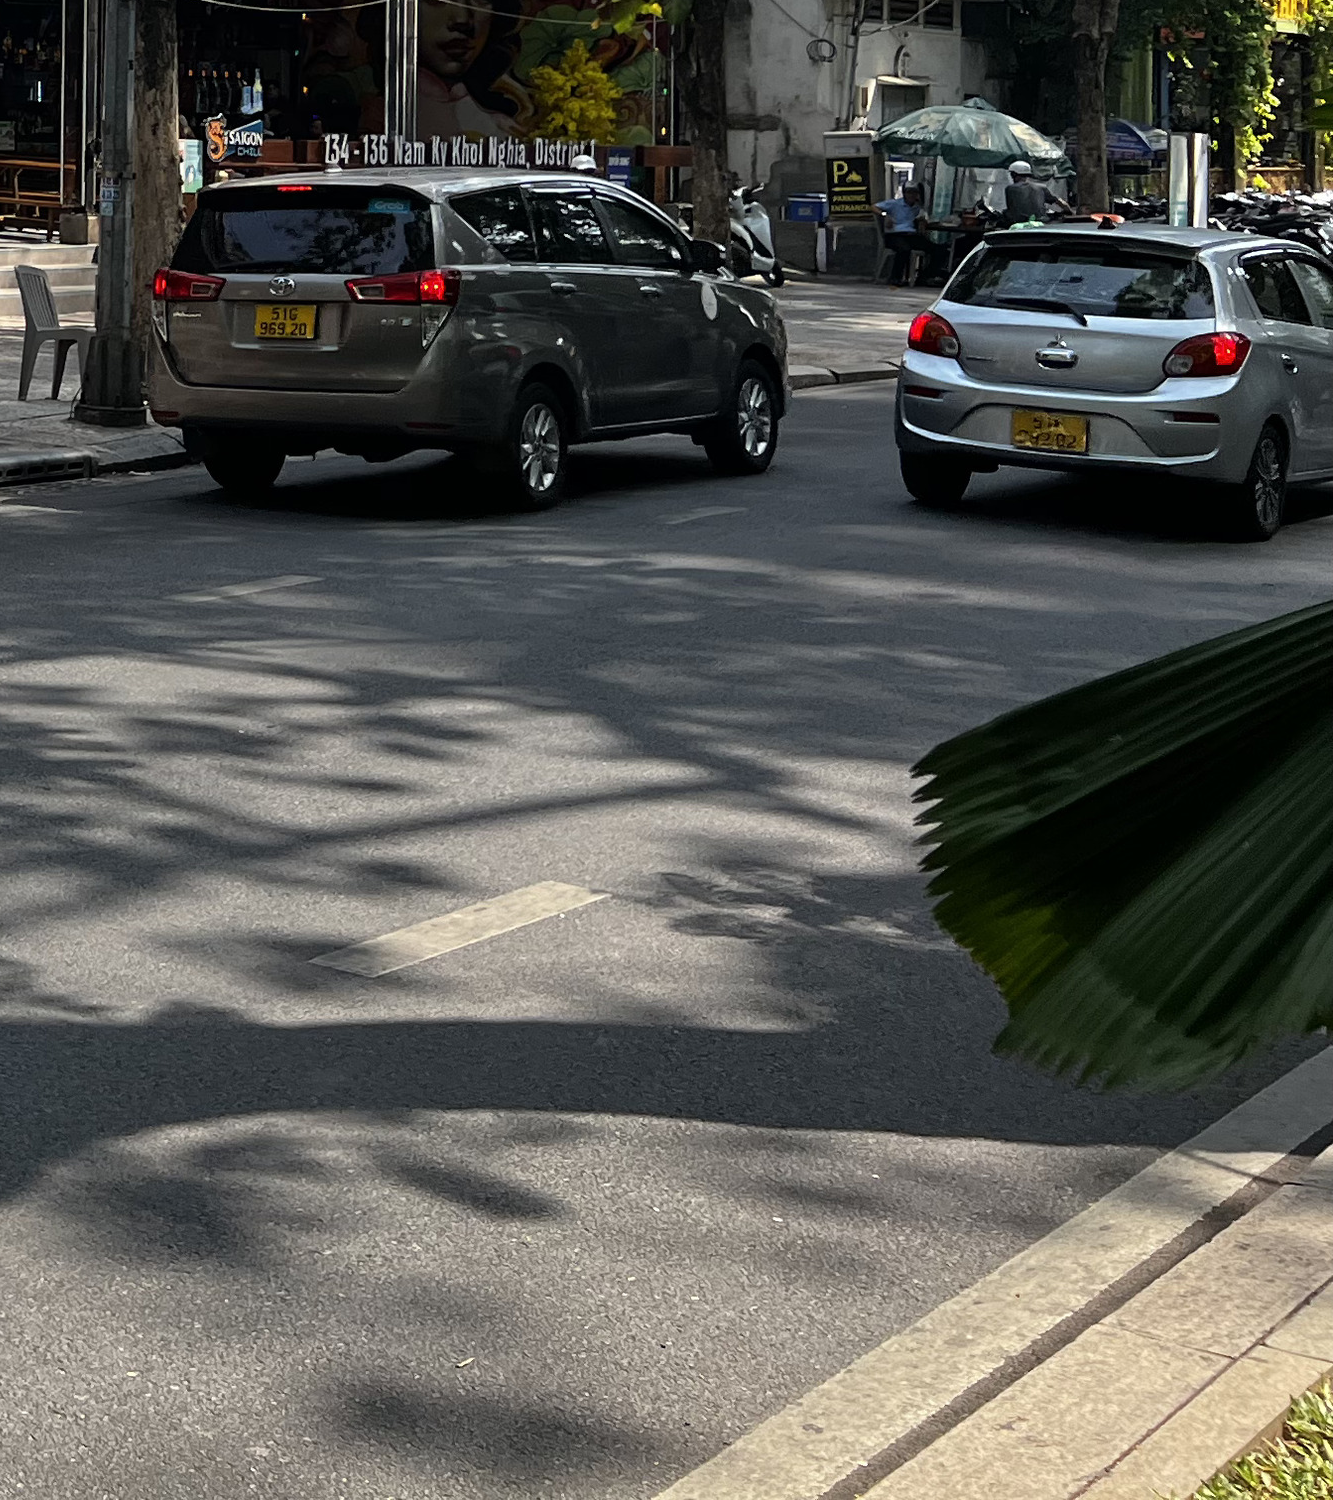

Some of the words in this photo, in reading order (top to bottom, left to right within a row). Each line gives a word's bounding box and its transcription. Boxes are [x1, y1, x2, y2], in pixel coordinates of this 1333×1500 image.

[229, 131, 263, 146] SAIGON
[394, 135, 425, 165] Nam
[432, 135, 448, 167] Ky
[452, 135, 483, 165] Khoi
[833, 161, 848, 184] P
[271, 307, 298, 321] 51G
[260, 322, 307, 336] 969.20
